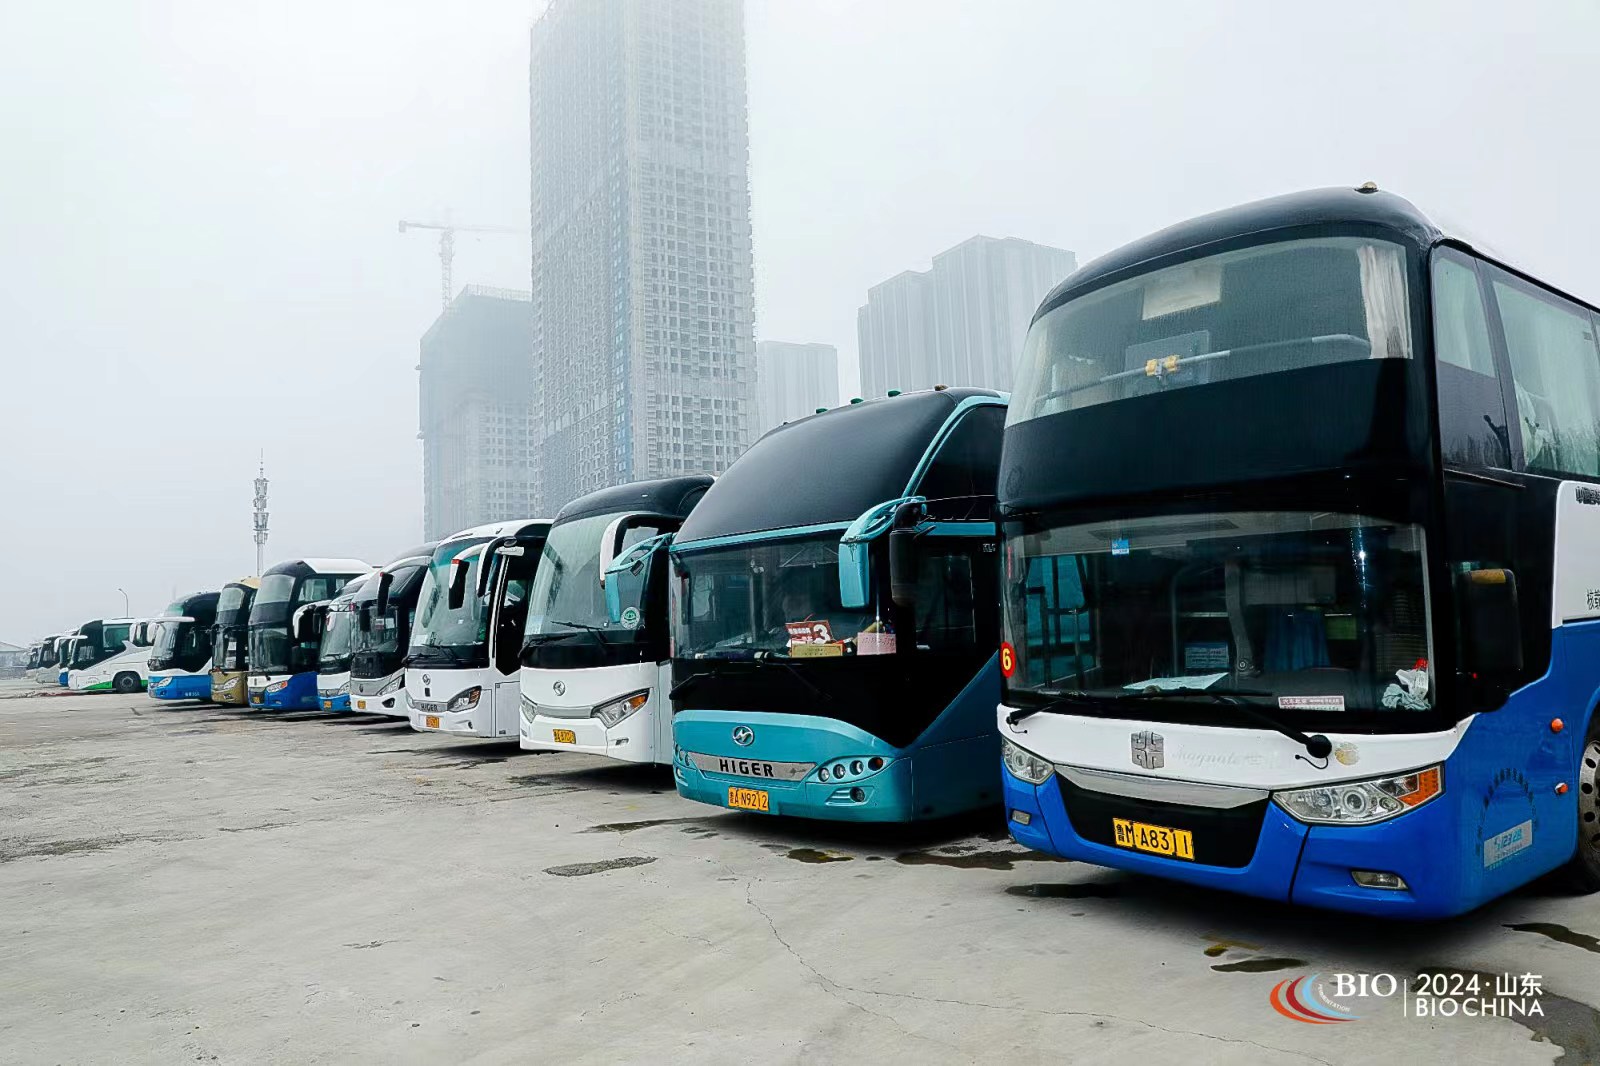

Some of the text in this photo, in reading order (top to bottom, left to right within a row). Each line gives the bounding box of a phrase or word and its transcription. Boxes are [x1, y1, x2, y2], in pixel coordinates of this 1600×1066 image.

[813, 624, 831, 645] 3
[1002, 648, 1012, 670] 6
[719, 759, 774, 777] HIGER
